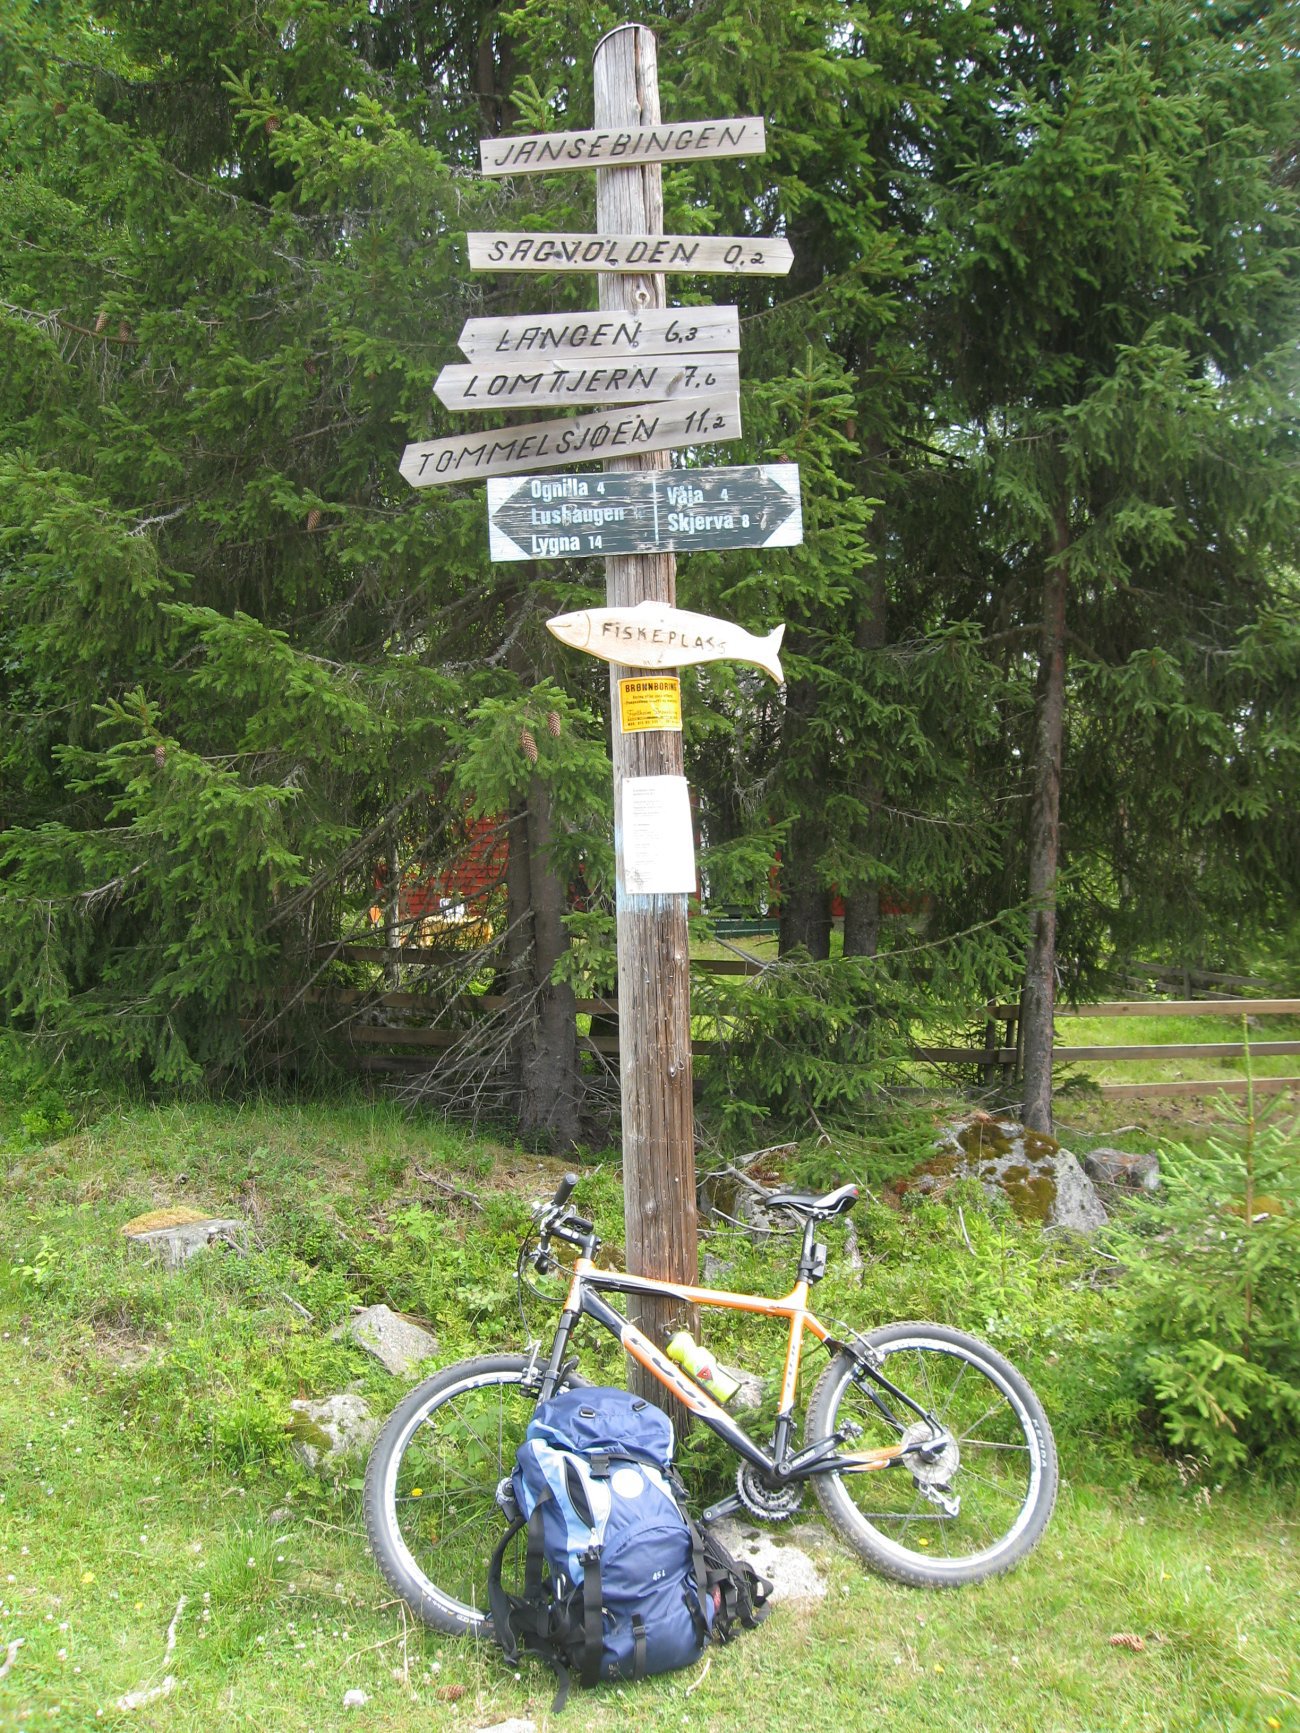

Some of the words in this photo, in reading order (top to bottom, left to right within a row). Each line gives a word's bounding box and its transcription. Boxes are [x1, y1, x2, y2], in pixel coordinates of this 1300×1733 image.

[494, 124, 746, 167] JANSEBINGEN
[488, 239, 700, 265] SAGVOLDEN
[496, 321, 643, 352] LANGEN
[463, 367, 658, 398] LOMTJERN
[417, 416, 659, 477] TOMMELSJØEN
[531, 478, 589, 503] Ognilla
[596, 481, 606, 495] 4
[720, 488, 729, 502] 4
[667, 512, 734, 535] Skjerva
[741, 514, 750, 528] 8
[531, 534, 581, 557] Lygna
[588, 535, 603, 550] 14
[1031, 1418, 1048, 1468] KENDA
